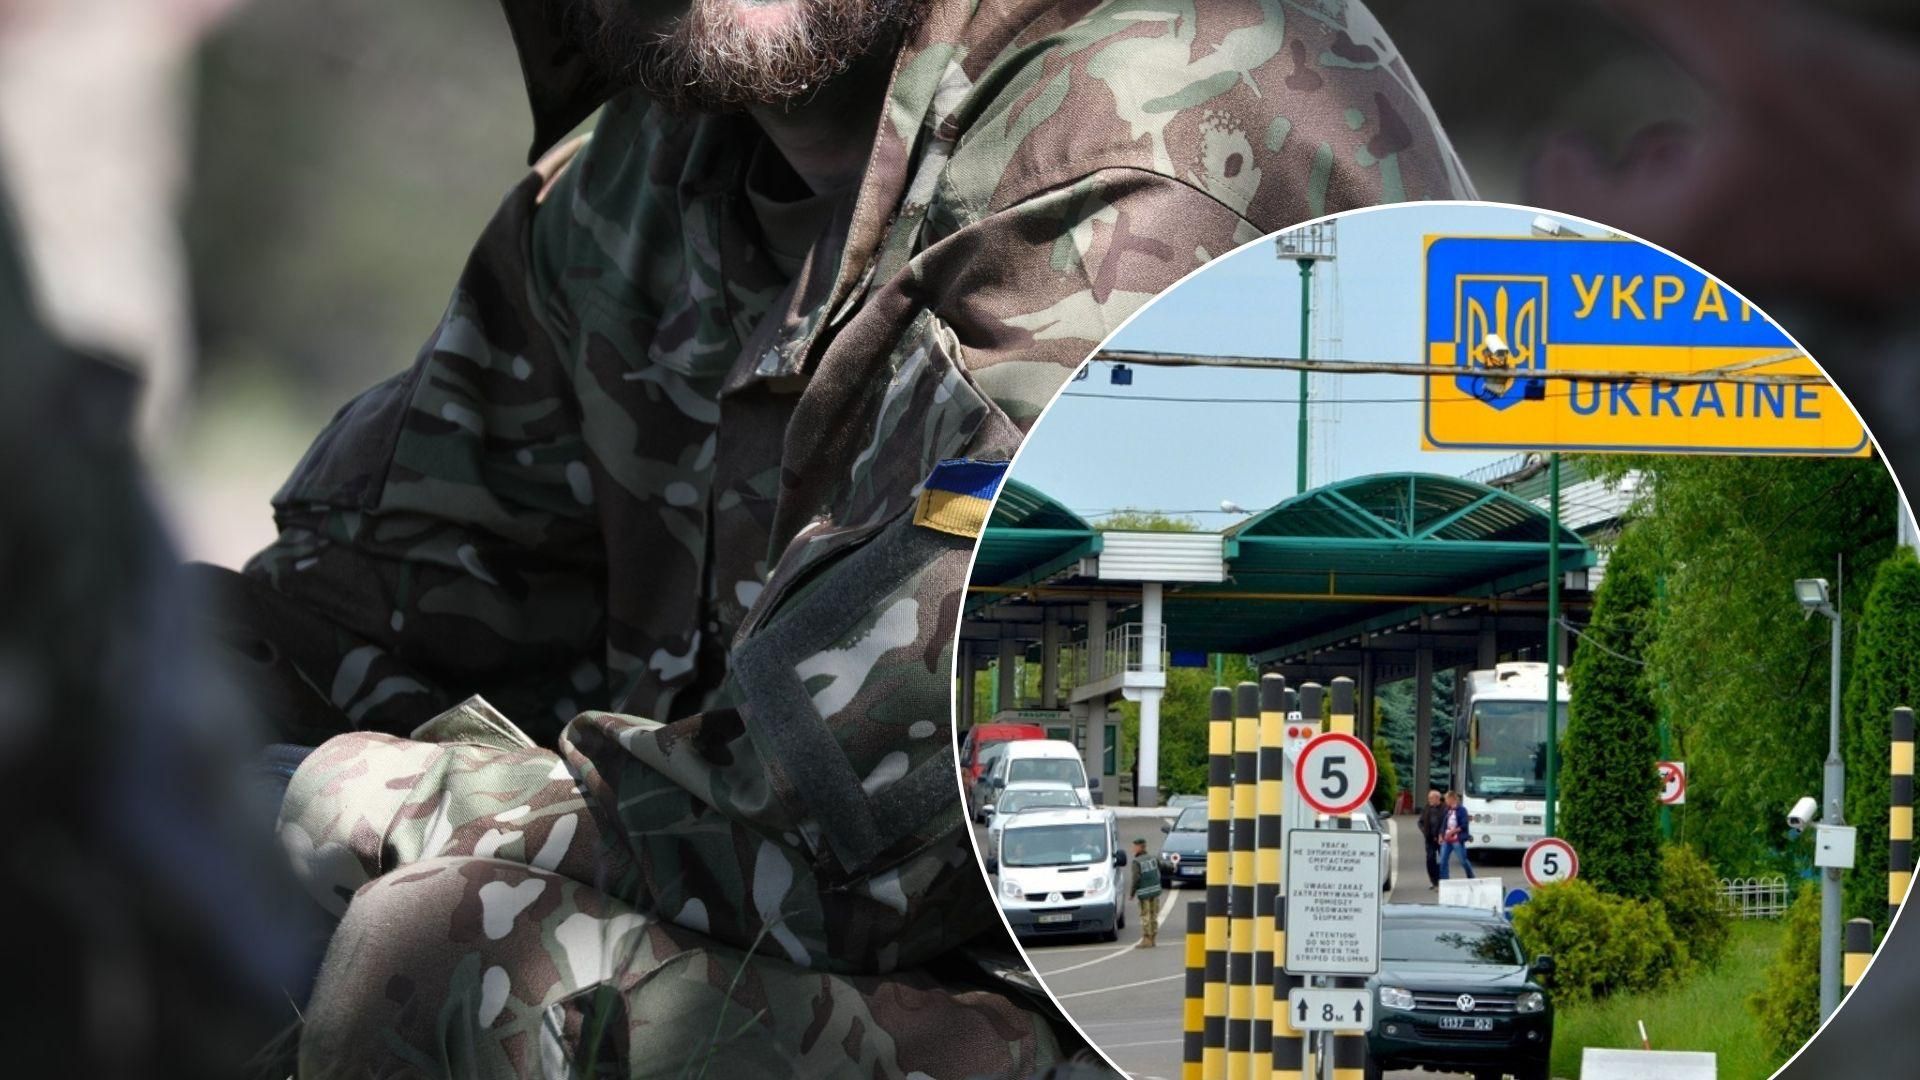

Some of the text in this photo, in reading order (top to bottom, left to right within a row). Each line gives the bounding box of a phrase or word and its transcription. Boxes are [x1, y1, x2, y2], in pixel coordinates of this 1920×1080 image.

[1568, 379, 1822, 419] UKRAINE
[1320, 755, 1349, 799] 5
[1543, 853, 1558, 876] 5
